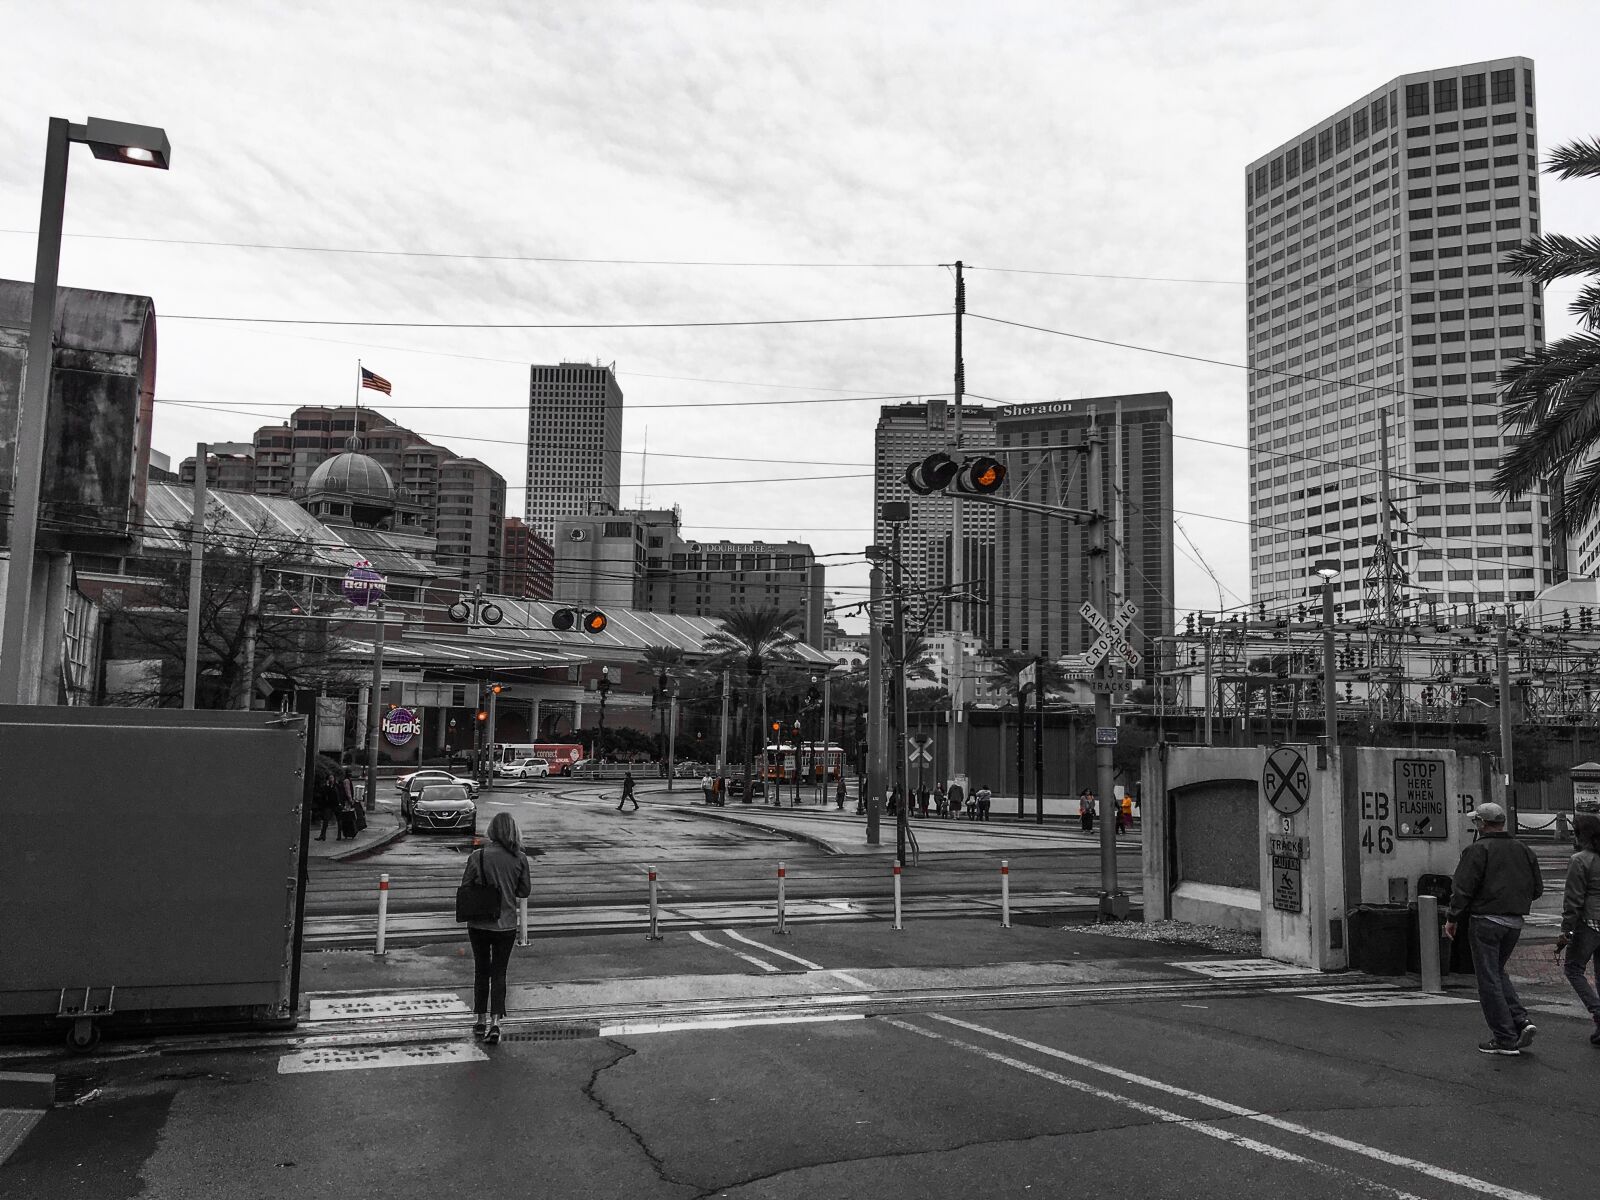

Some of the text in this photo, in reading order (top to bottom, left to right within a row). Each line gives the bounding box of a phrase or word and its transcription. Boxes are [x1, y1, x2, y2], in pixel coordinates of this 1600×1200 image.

[1003, 402, 1073, 417] Sheraton
[1085, 604, 1136, 666] CROSSING
[1092, 682, 1130, 691] TRACKS
[536, 750, 558, 758] connect
[1402, 763, 1437, 778] STOP
[1407, 779, 1433, 789] HERE
[1407, 790, 1434, 800] WHEN
[1361, 792, 1390, 820] EB
[1400, 802, 1442, 814] FLASHING
[1283, 819, 1290, 832] 3
[1361, 825, 1393, 854] 46
